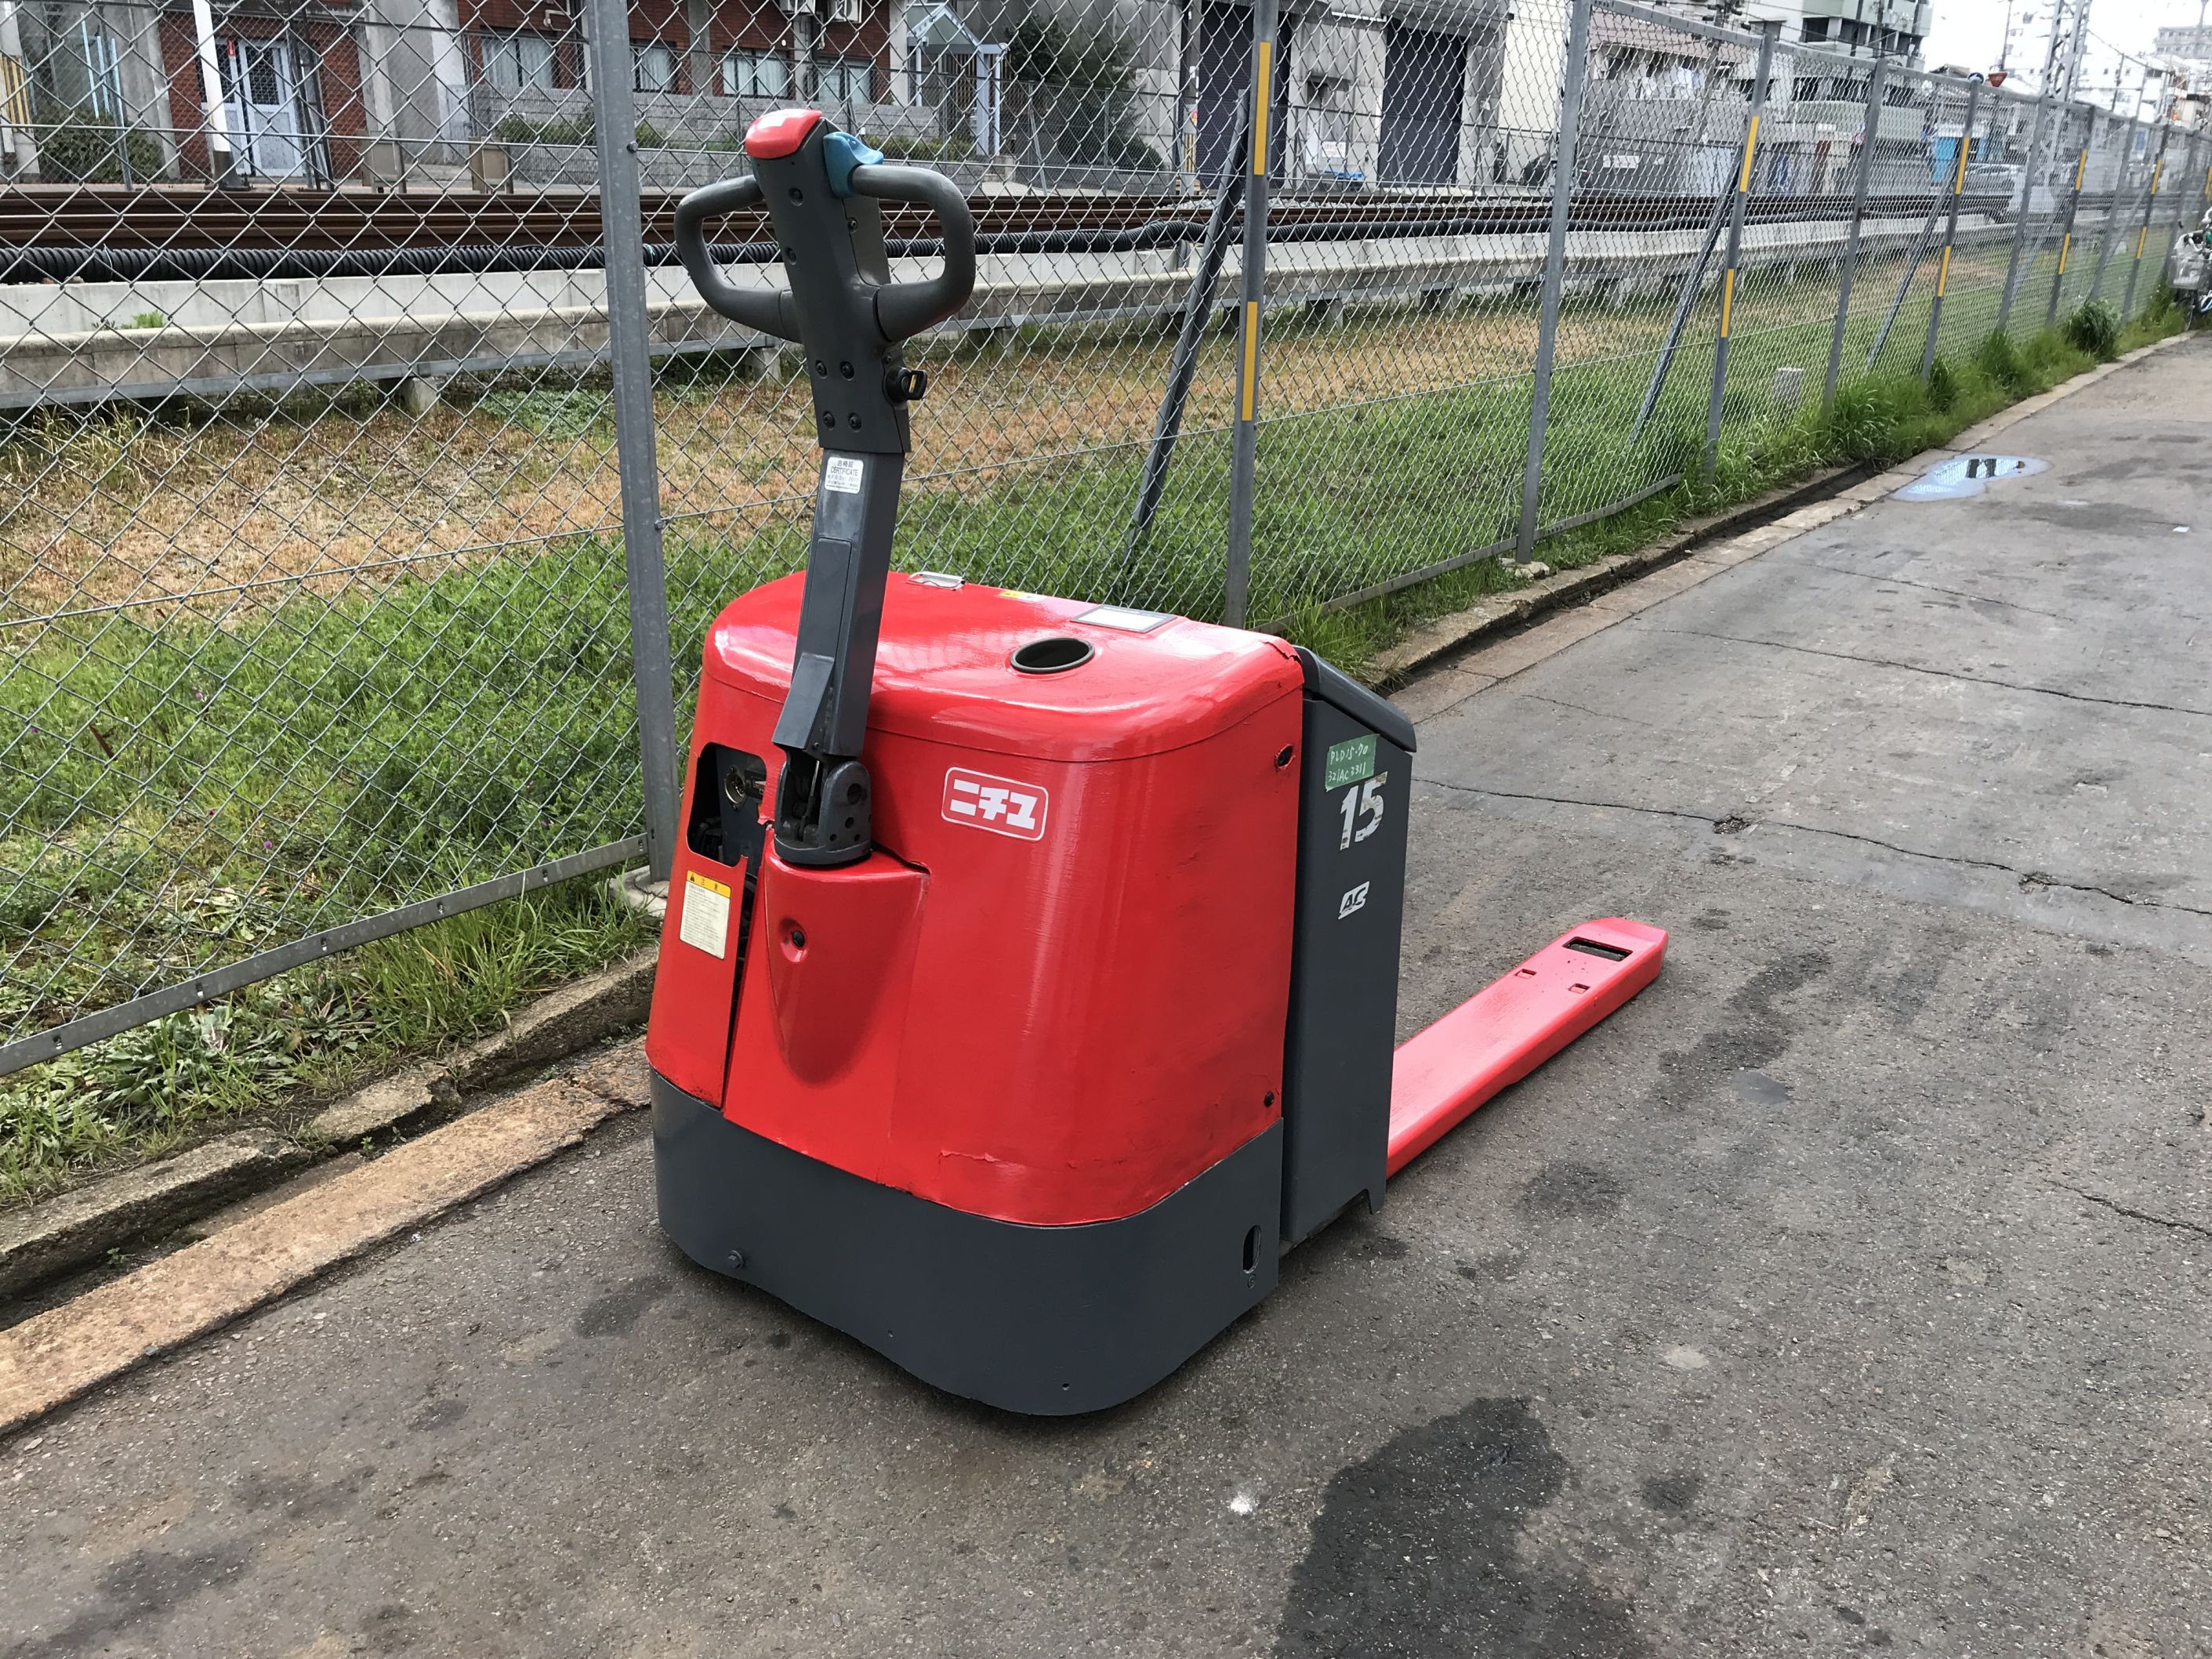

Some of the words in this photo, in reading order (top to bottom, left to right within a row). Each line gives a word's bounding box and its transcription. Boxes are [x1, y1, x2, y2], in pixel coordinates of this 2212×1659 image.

[830, 466, 859, 476] CERTIFICATE
[1340, 771, 1387, 850] 15
[1341, 886, 1366, 912] AC
